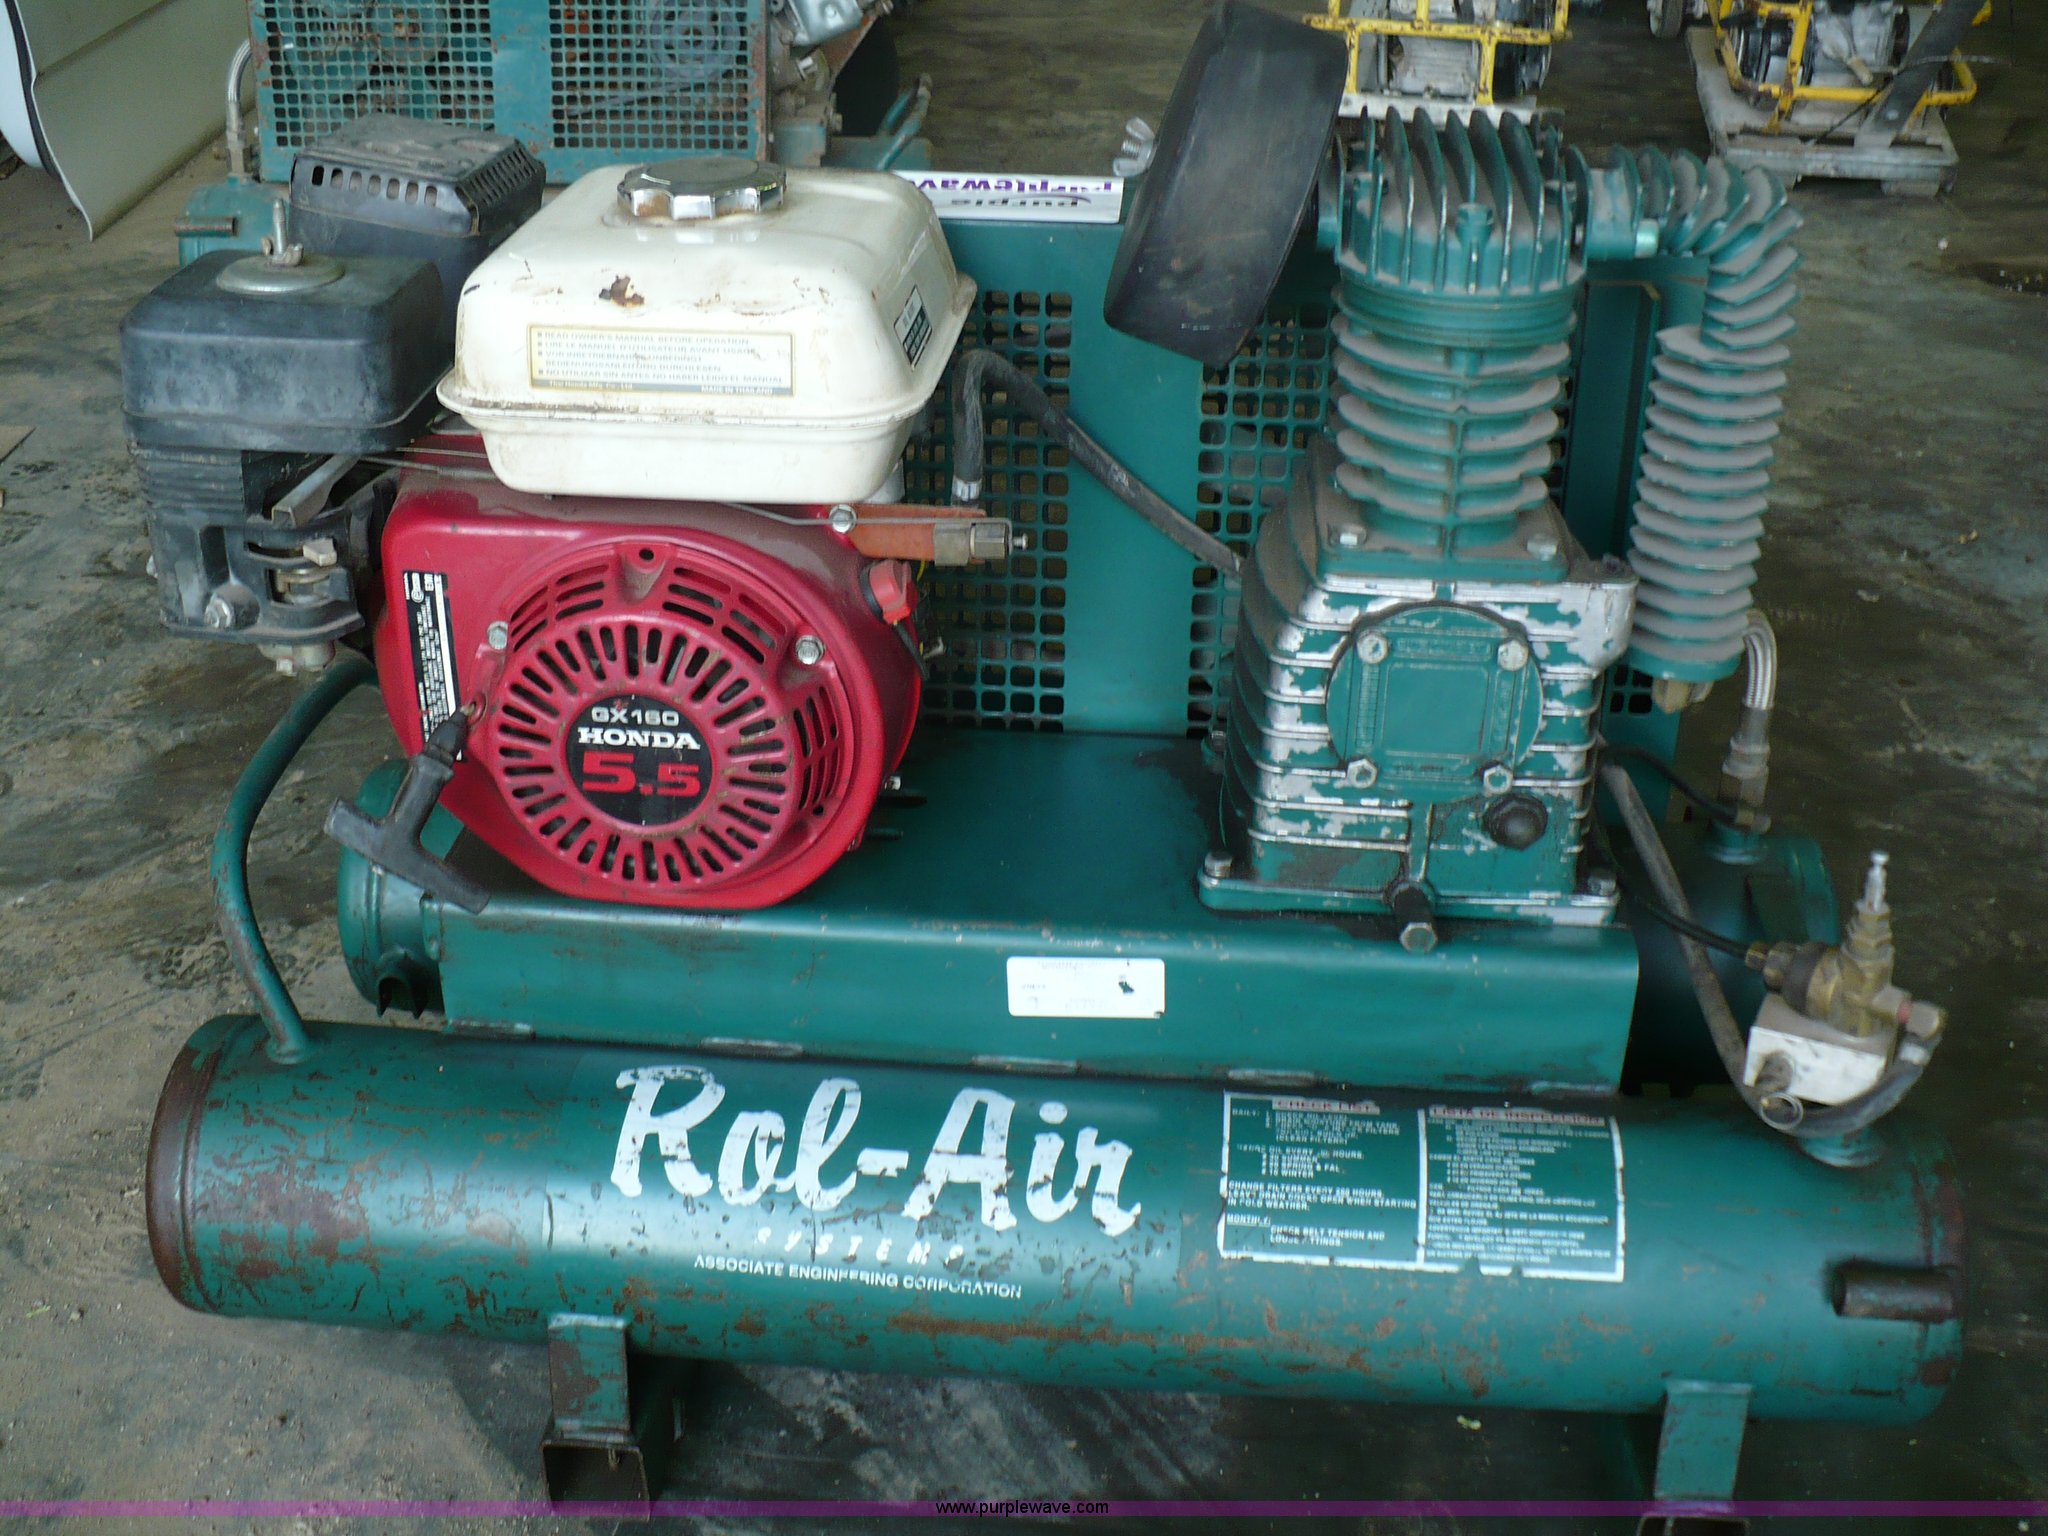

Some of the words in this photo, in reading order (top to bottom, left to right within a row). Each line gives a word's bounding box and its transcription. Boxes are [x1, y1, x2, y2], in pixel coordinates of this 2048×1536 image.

[615, 334, 655, 343] MANUAL
[696, 336, 749, 346] OPERATION
[577, 726, 702, 750] HONDA
[582, 749, 702, 798] 5.5
[610, 1064, 1144, 1238] Rol-Air
[1228, 1179, 1265, 1191] CHANGE
[1267, 1181, 1303, 1192] FILTERS
[1305, 1184, 1334, 1194] EVERY
[1373, 1197, 1417, 1209] STARTING
[1270, 1224, 1301, 1237] CHECK
[1302, 1226, 1325, 1238] BELT
[1327, 1227, 1365, 1240] TENSION
[1367, 1229, 1386, 1242] AND
[693, 1253, 785, 1277] ASSOCIATE
